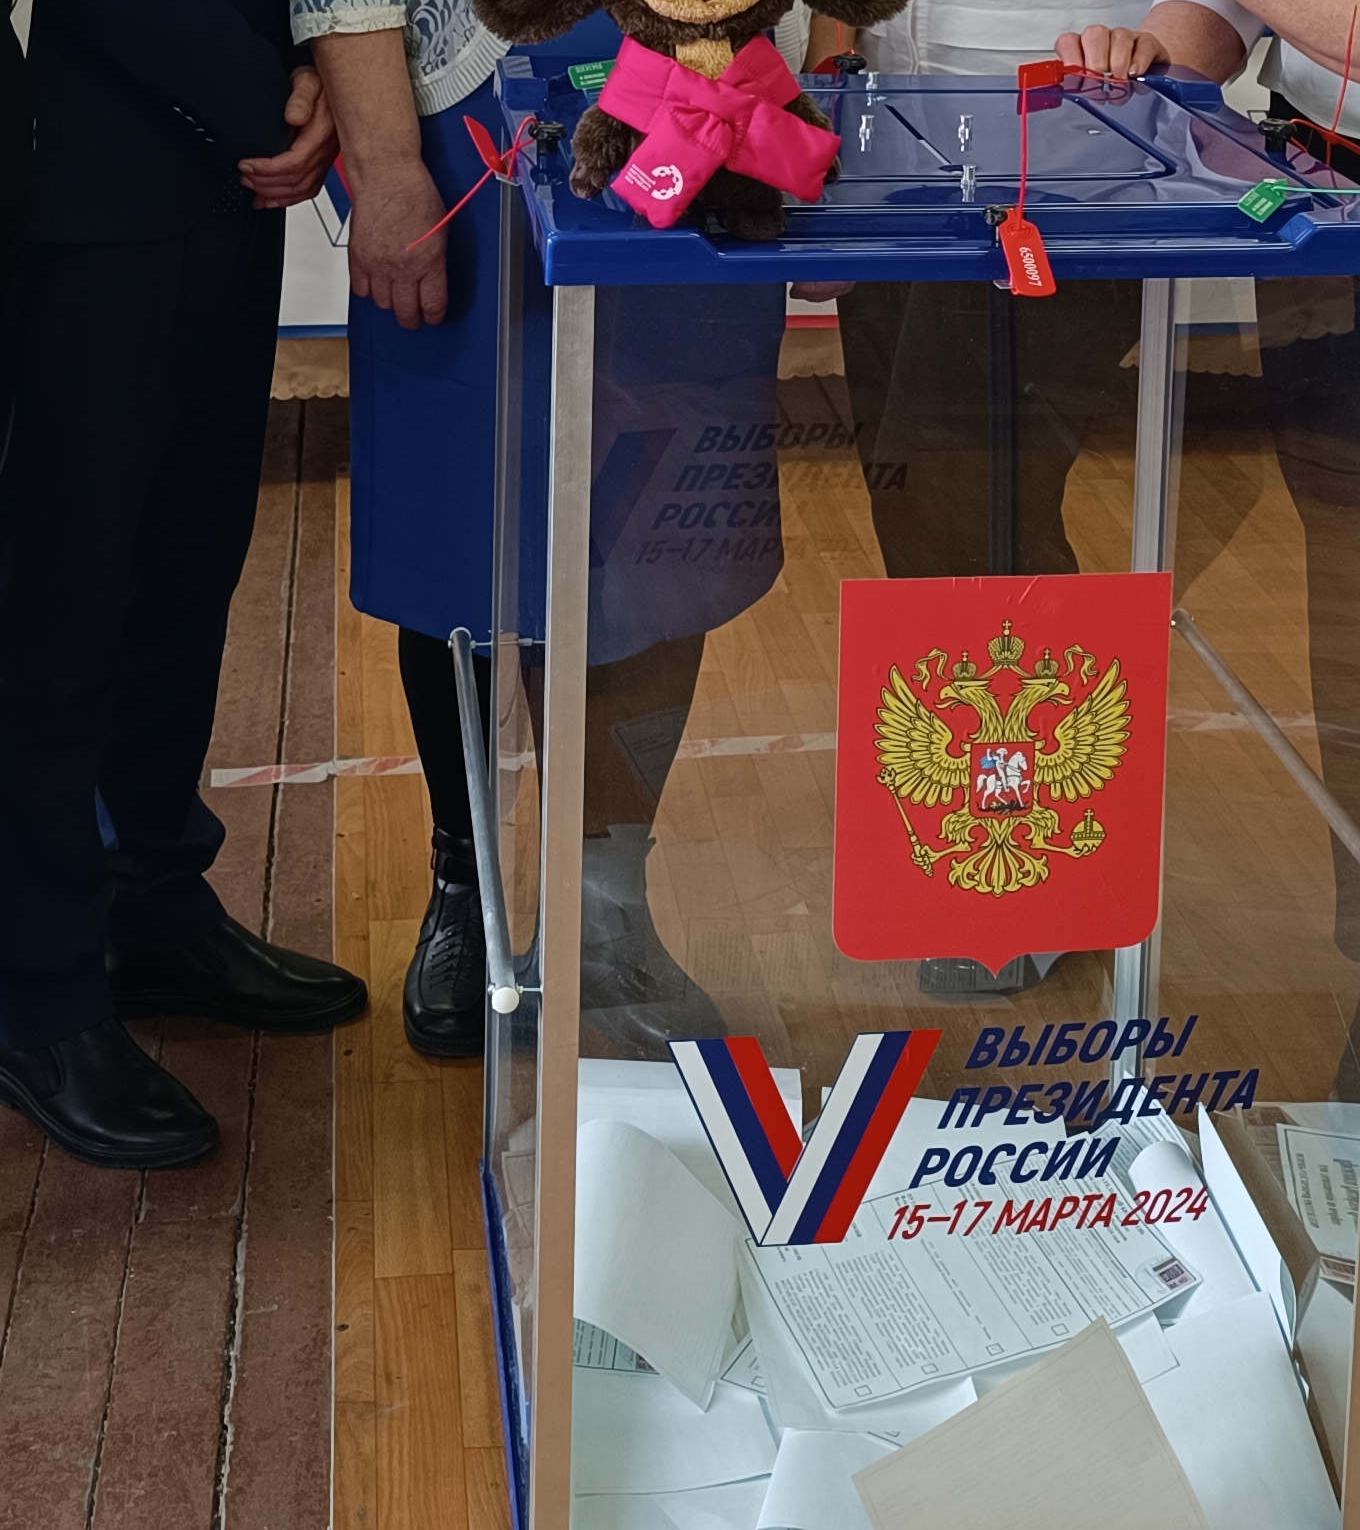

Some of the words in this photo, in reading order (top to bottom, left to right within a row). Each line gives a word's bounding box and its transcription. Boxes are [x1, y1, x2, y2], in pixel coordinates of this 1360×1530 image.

[965, 1015, 1198, 1069] ВЫБОРЫ
[937, 1068, 1260, 1133] ПРЕЗИДЕНТА
[908, 1137, 1121, 1189] РОССИИ
[992, 1193, 1118, 1237] МАРТА
[1121, 1186, 1209, 1227] 2024
